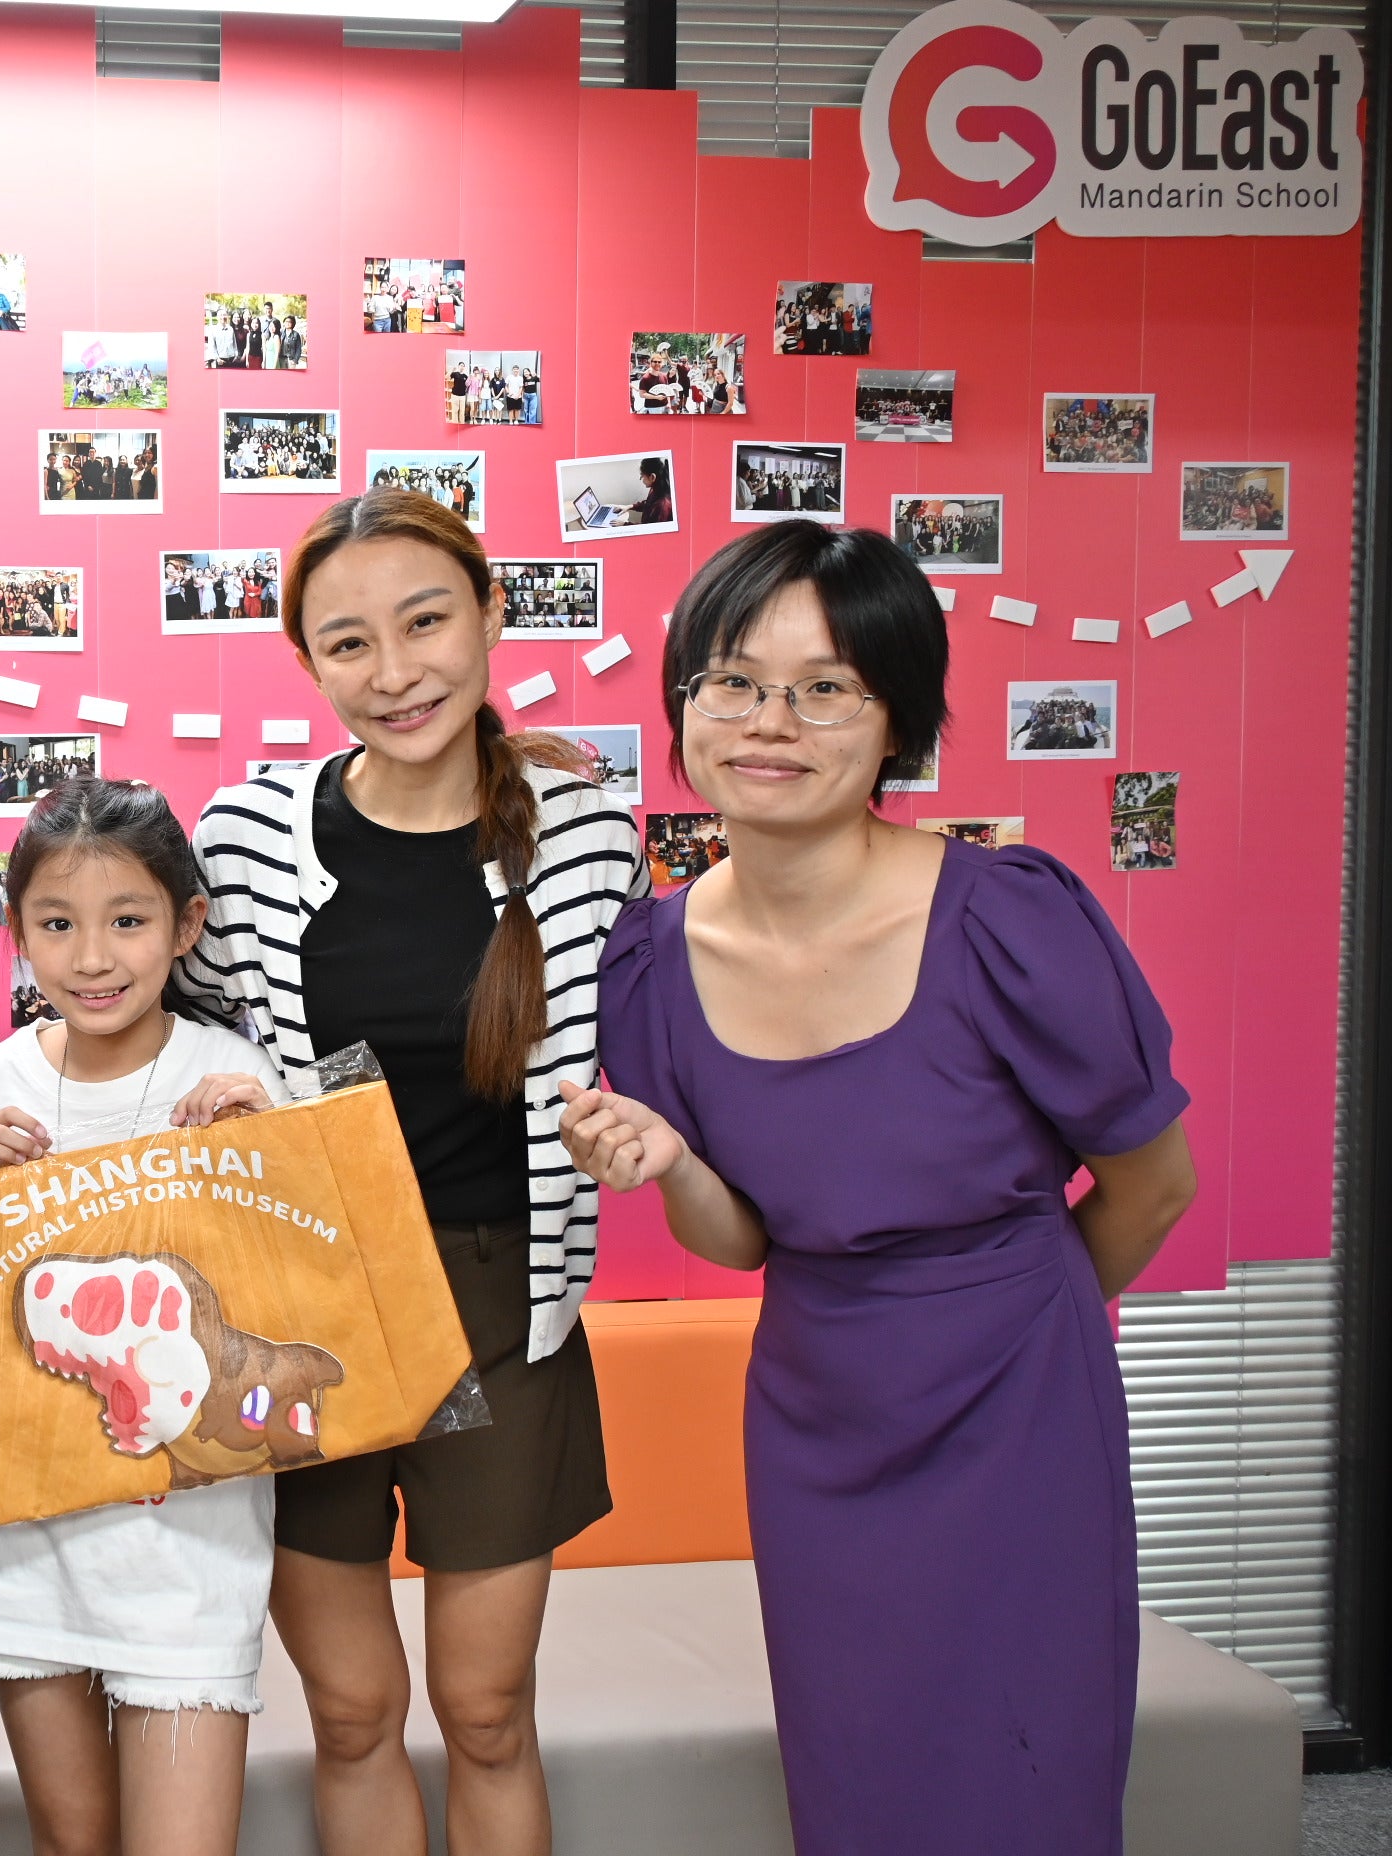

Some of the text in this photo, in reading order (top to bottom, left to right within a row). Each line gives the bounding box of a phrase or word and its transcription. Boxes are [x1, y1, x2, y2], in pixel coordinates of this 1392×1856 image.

[1081, 44, 1341, 172] GoEast
[1080, 182, 1339, 209] Mandarin School
[78, 1180, 205, 1222] HISTORY
[211, 1184, 339, 1244] MUSEUM
